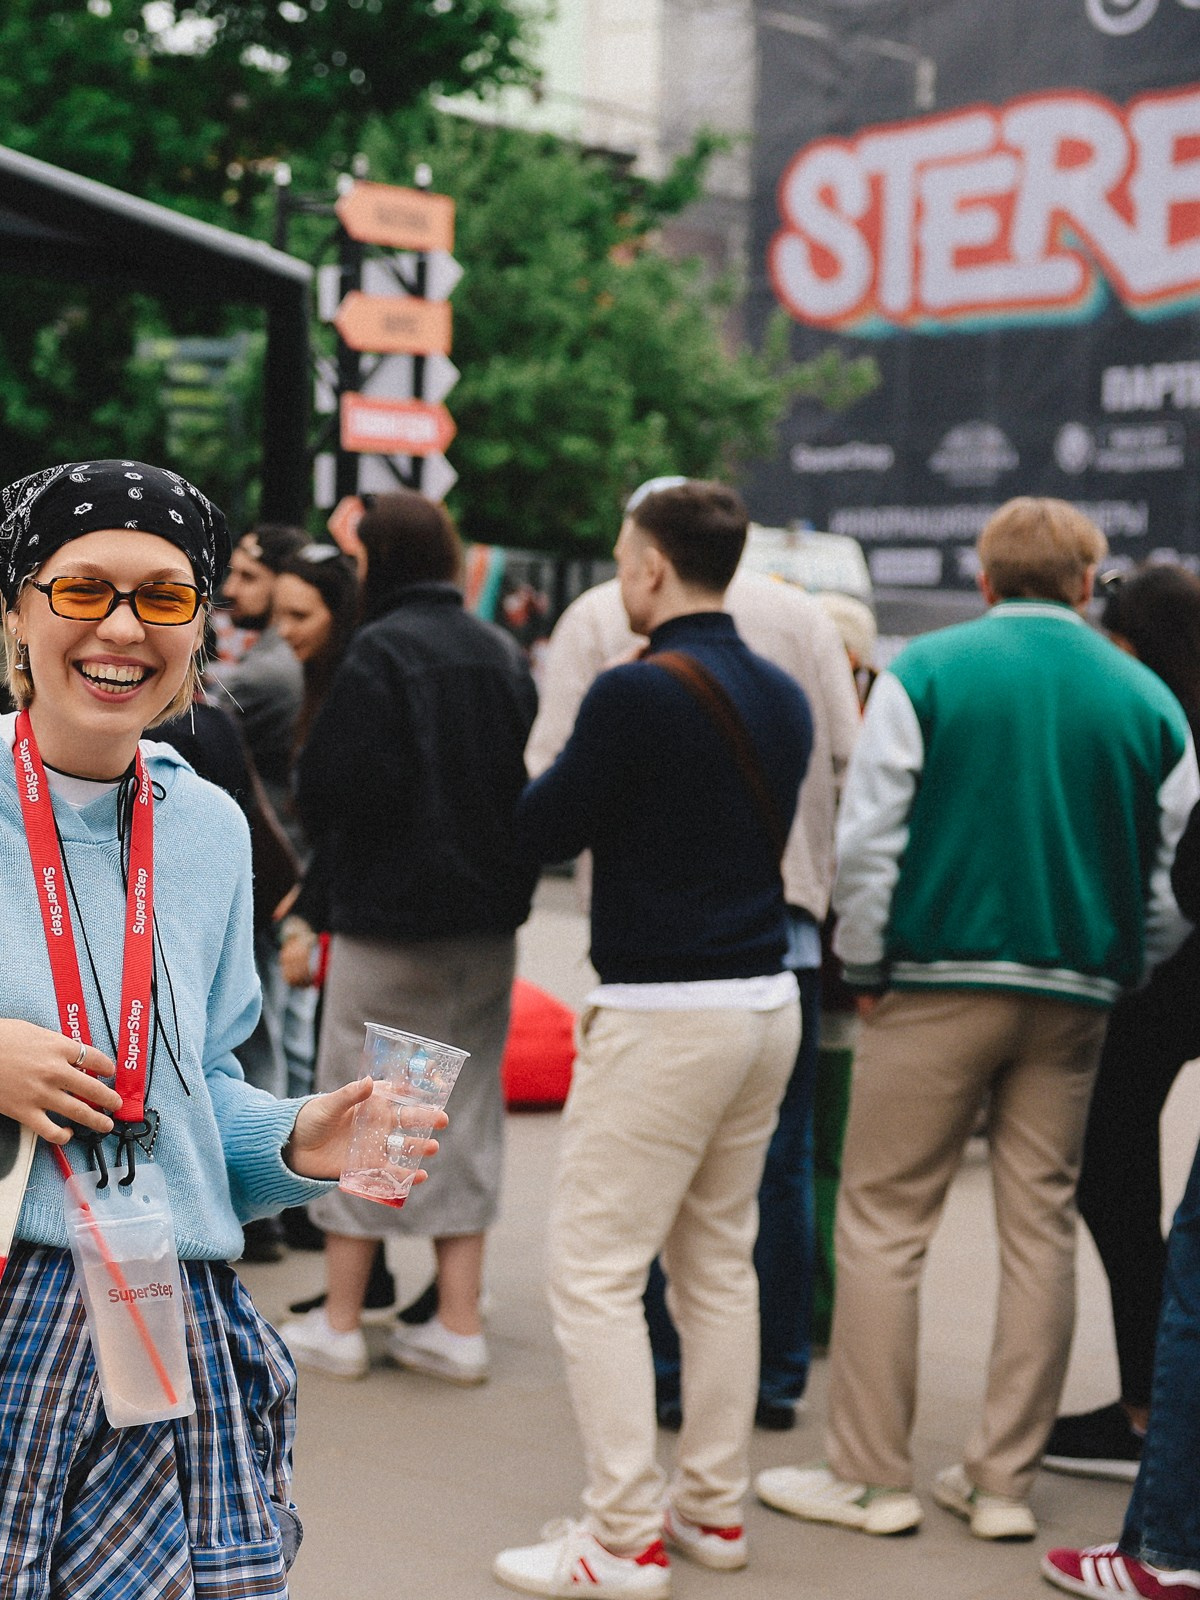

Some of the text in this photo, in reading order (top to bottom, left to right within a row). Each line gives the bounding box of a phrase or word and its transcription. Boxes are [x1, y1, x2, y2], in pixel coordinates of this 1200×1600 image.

[19, 738, 39, 803] SuperStep
[42, 866, 63, 936] SuperStep
[133, 867, 148, 935] SuperStep
[124, 999, 144, 1070] SuperStep
